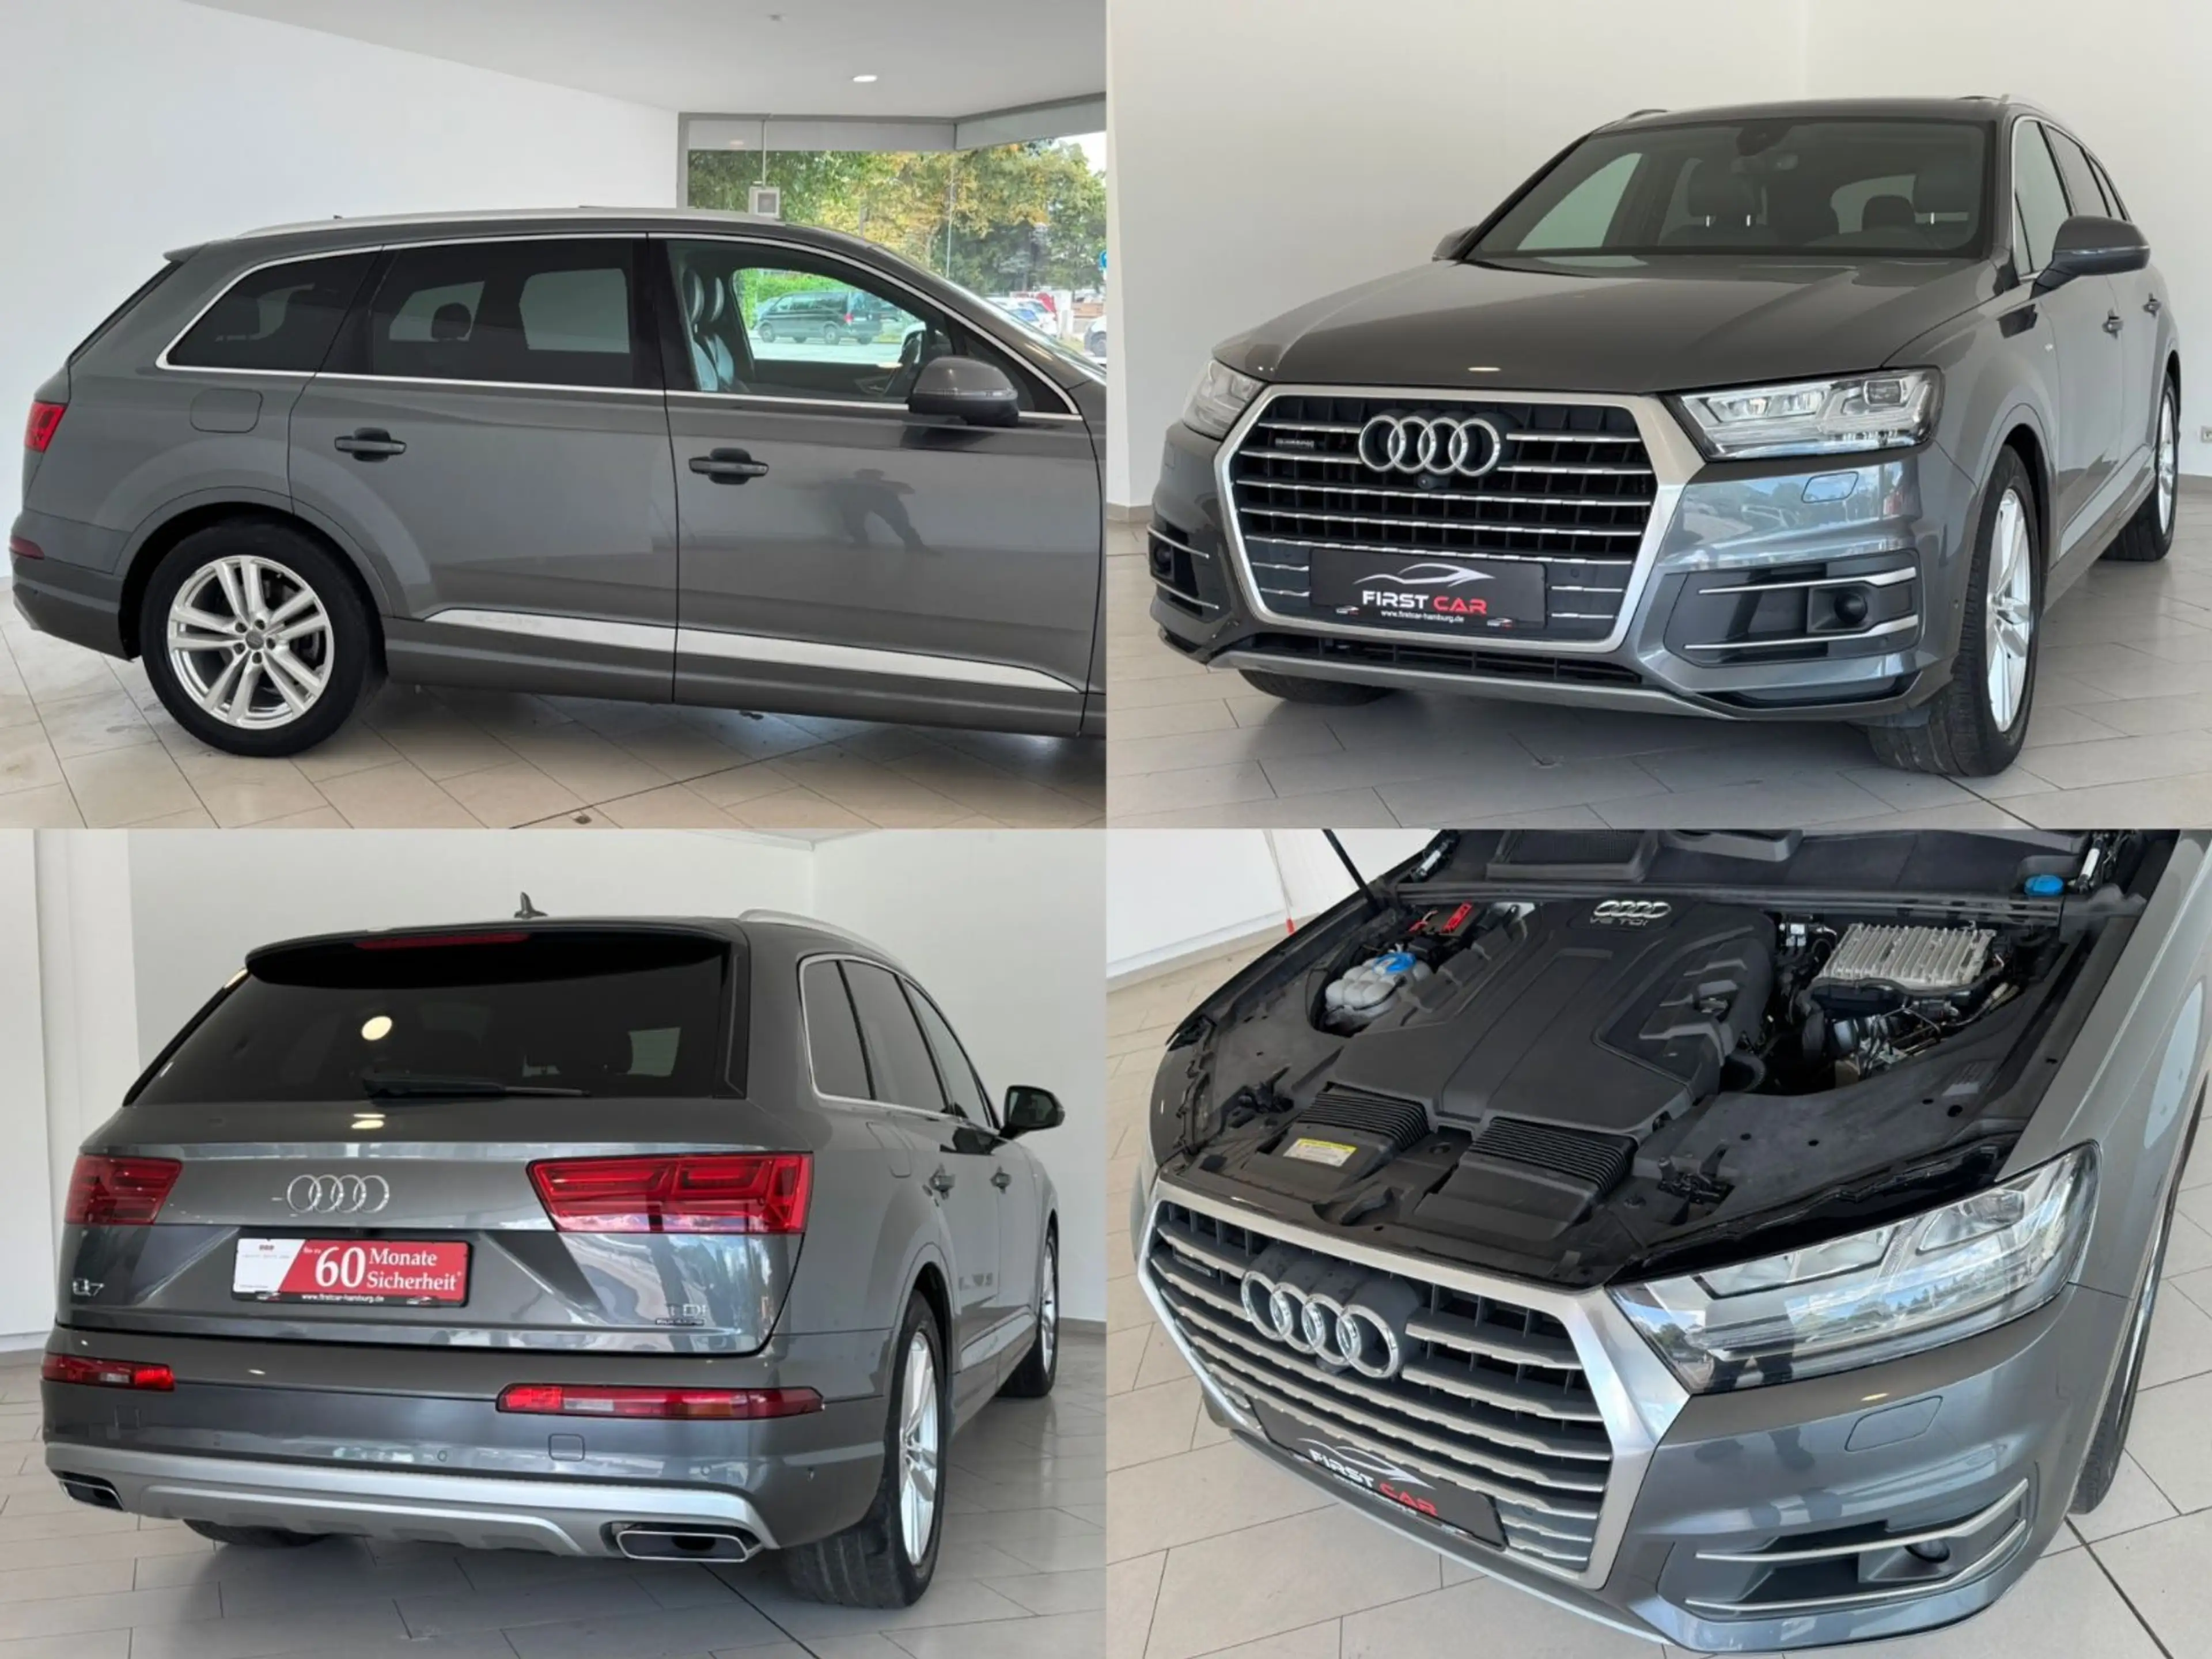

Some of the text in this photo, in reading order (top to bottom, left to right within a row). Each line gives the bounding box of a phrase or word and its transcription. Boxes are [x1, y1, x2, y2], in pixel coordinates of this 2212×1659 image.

[1362, 590, 1487, 614] FIRST CAR
[315, 1247, 437, 1287] 60 Monate
[1379, 1483, 1438, 1516] CAR
